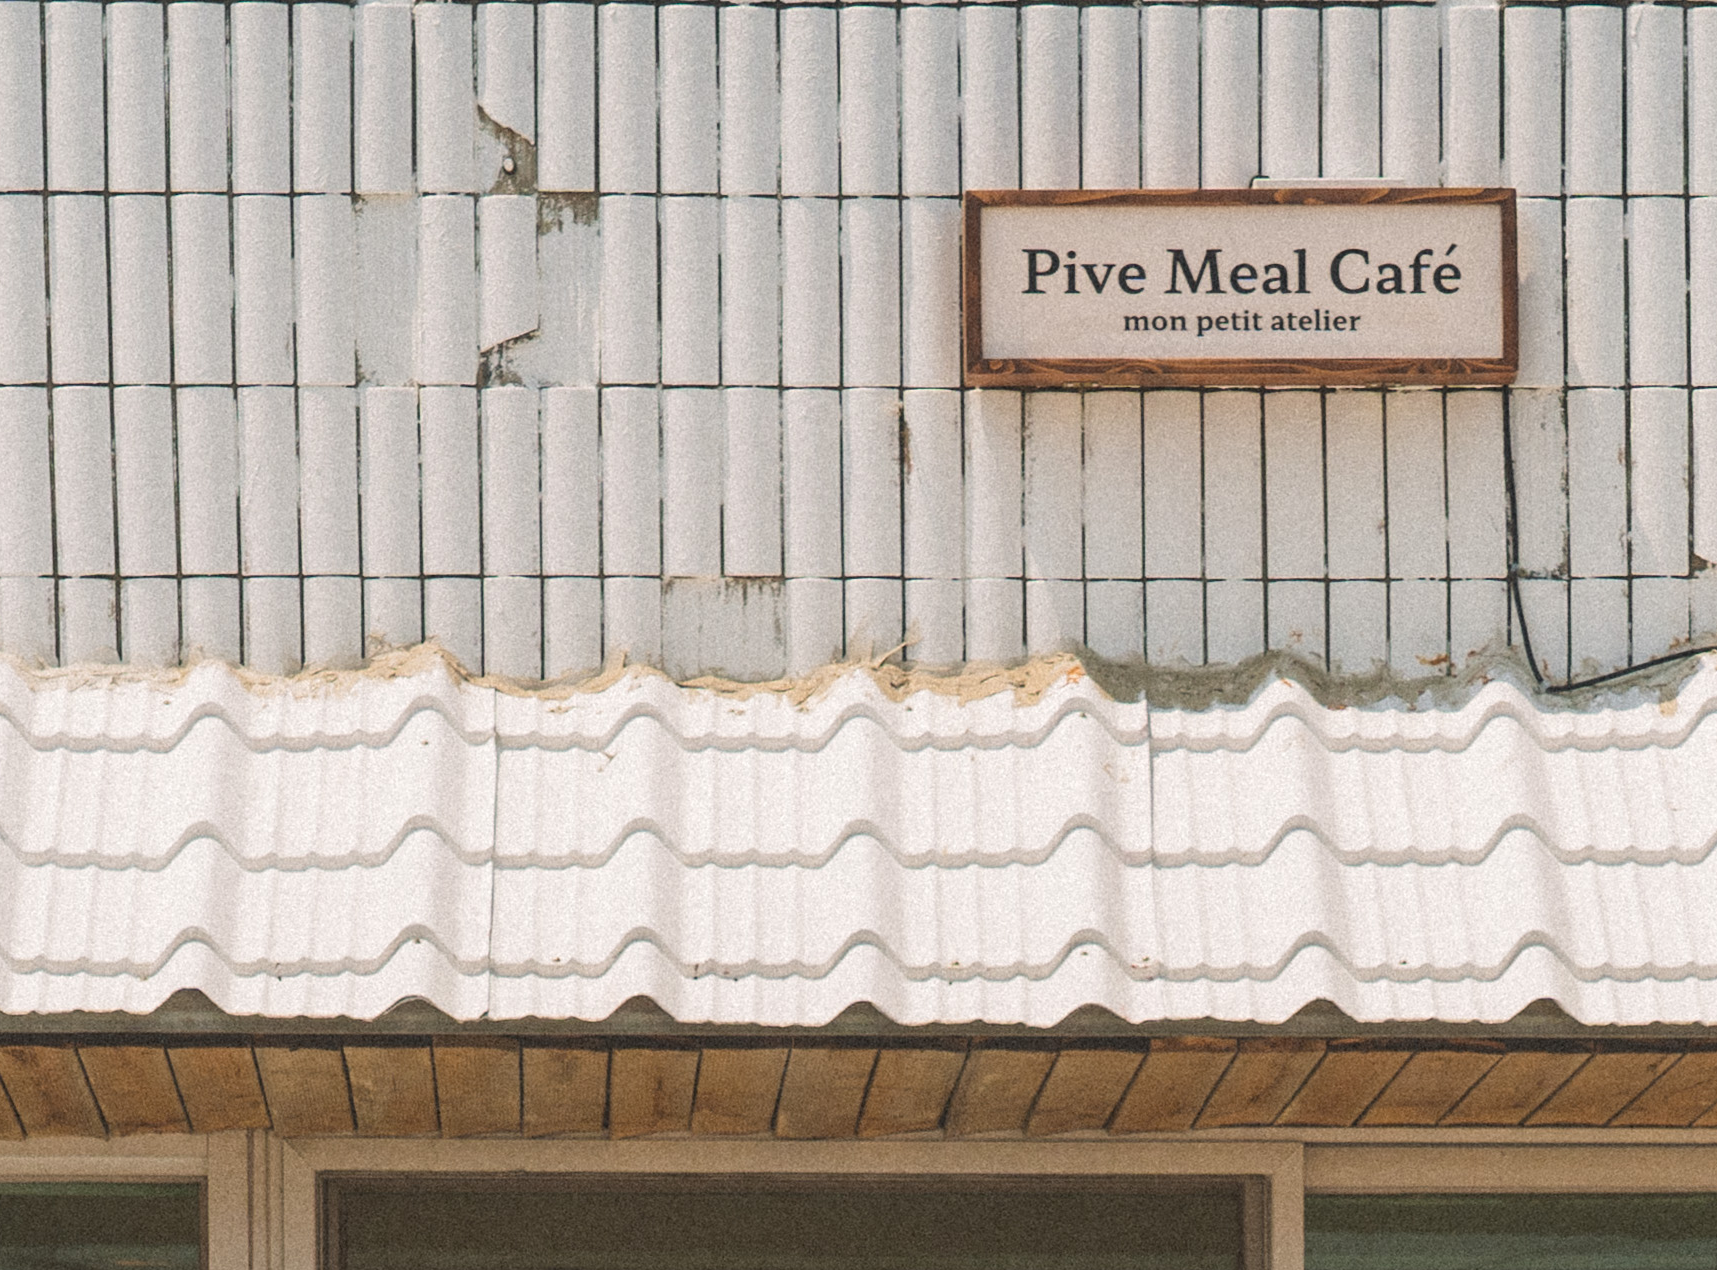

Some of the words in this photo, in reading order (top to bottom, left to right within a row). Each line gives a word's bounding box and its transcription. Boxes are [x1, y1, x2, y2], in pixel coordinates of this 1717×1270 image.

[1020, 247, 1147, 295] Pive
[1164, 247, 1311, 295] Meal
[1329, 242, 1463, 295] Café
[1123, 312, 1187, 332] mon
[1195, 308, 1263, 337] petit
[1270, 308, 1361, 332] atelier
